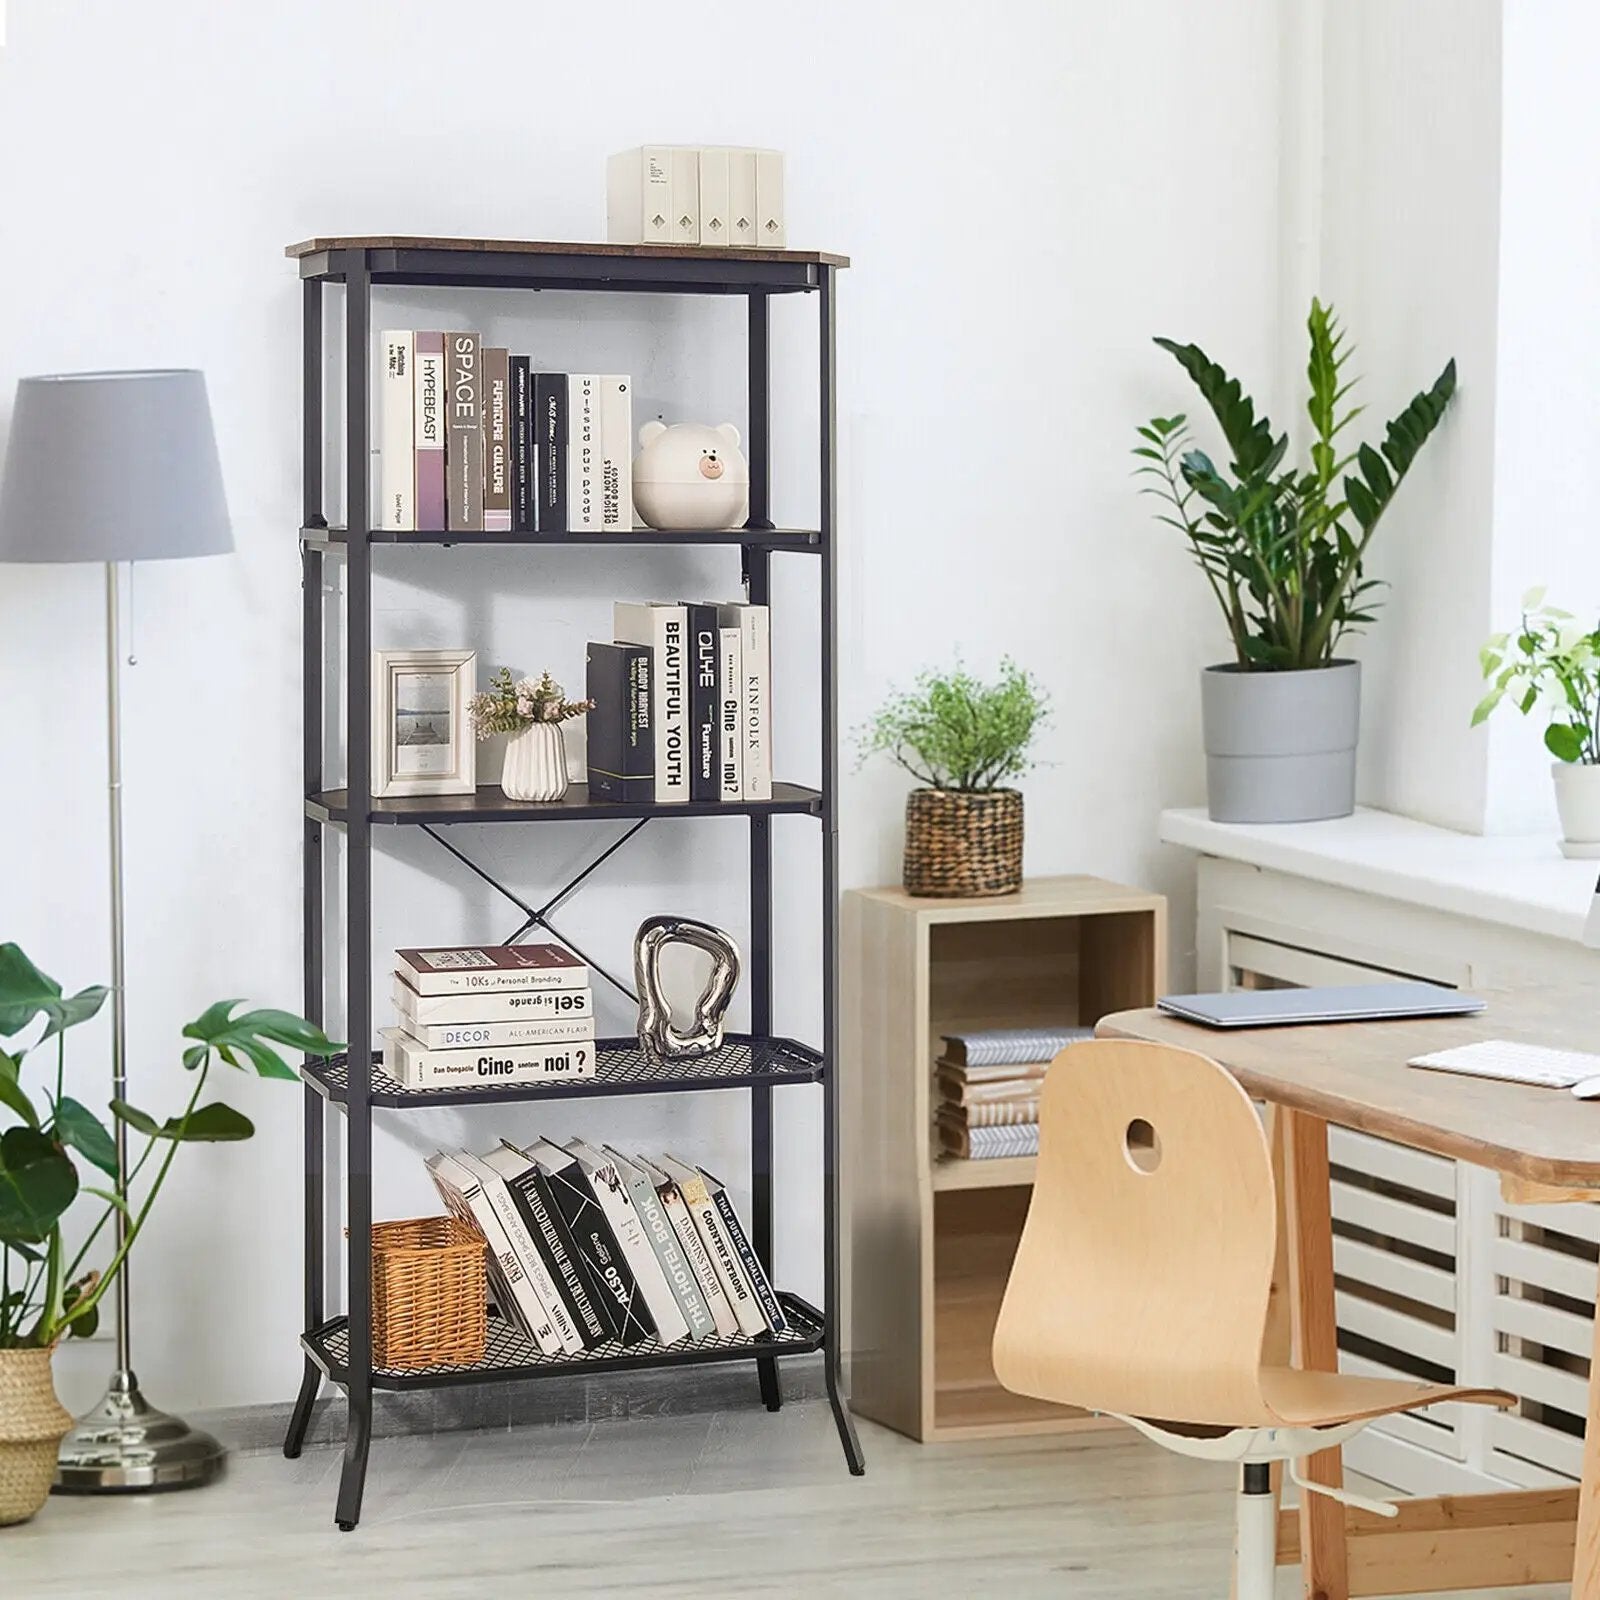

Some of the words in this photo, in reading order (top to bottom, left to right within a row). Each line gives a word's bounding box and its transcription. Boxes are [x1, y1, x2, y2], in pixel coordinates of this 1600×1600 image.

[455, 337, 474, 418] SPACE
[424, 359, 436, 442] HYPEBEAST
[492, 380, 504, 441] FURNITURE
[582, 379, 591, 443] passion
[493, 445, 504, 494] CULTURE
[582, 448, 591, 473] and
[603, 459, 612, 491] HOTELS
[582, 479, 591, 523] speed
[603, 493, 612, 524] DESIGN
[611, 502, 619, 524] YEAR
[638, 657, 649, 689] BLOODY
[666, 621, 681, 720] BEAUTIFUL
[638, 691, 649, 728] HARVEST
[724, 700, 738, 732] Cine
[749, 676, 760, 749] KINFOLK
[666, 725, 681, 786] YOUTH
[702, 723, 712, 779] Furniture
[465, 977, 490, 986] 10Ks
[497, 976, 528, 985] Personal
[530, 975, 563, 985] Branding
[508, 996, 543, 1008] grande
[544, 997, 553, 1007] si
[555, 995, 585, 1014] sei
[446, 1030, 490, 1042] DECOR
[509, 1028, 565, 1038] ALL-AMERICAN
[566, 1026, 588, 1034] FLAIR
[433, 1066, 445, 1074] Dan
[477, 1056, 515, 1076] Cine
[523, 1187, 550, 1223] CENTURY
[640, 1196, 671, 1242] BOOK
[539, 1219, 567, 1264] TWENTIETH
[679, 1216, 705, 1265] DARWINS
[701, 1264, 721, 1297] TEORI
[702, 1209, 729, 1261] COUNTRY
[723, 1259, 748, 1301] STRONG
[717, 1196, 731, 1218] THAT
[728, 1218, 749, 1254] JUSTICE
[745, 1256, 763, 1285] SHALL
[757, 1284, 769, 1297] BE
[764, 1297, 780, 1322] DONE
[558, 1259, 573, 1278] THE
[604, 1266, 630, 1304] ALSO
[663, 1242, 694, 1296] HOTEL
[551, 1304, 573, 1340] FASHION
[569, 1282, 604, 1338] ARCHITECTURE
[683, 1292, 707, 1330] THE
